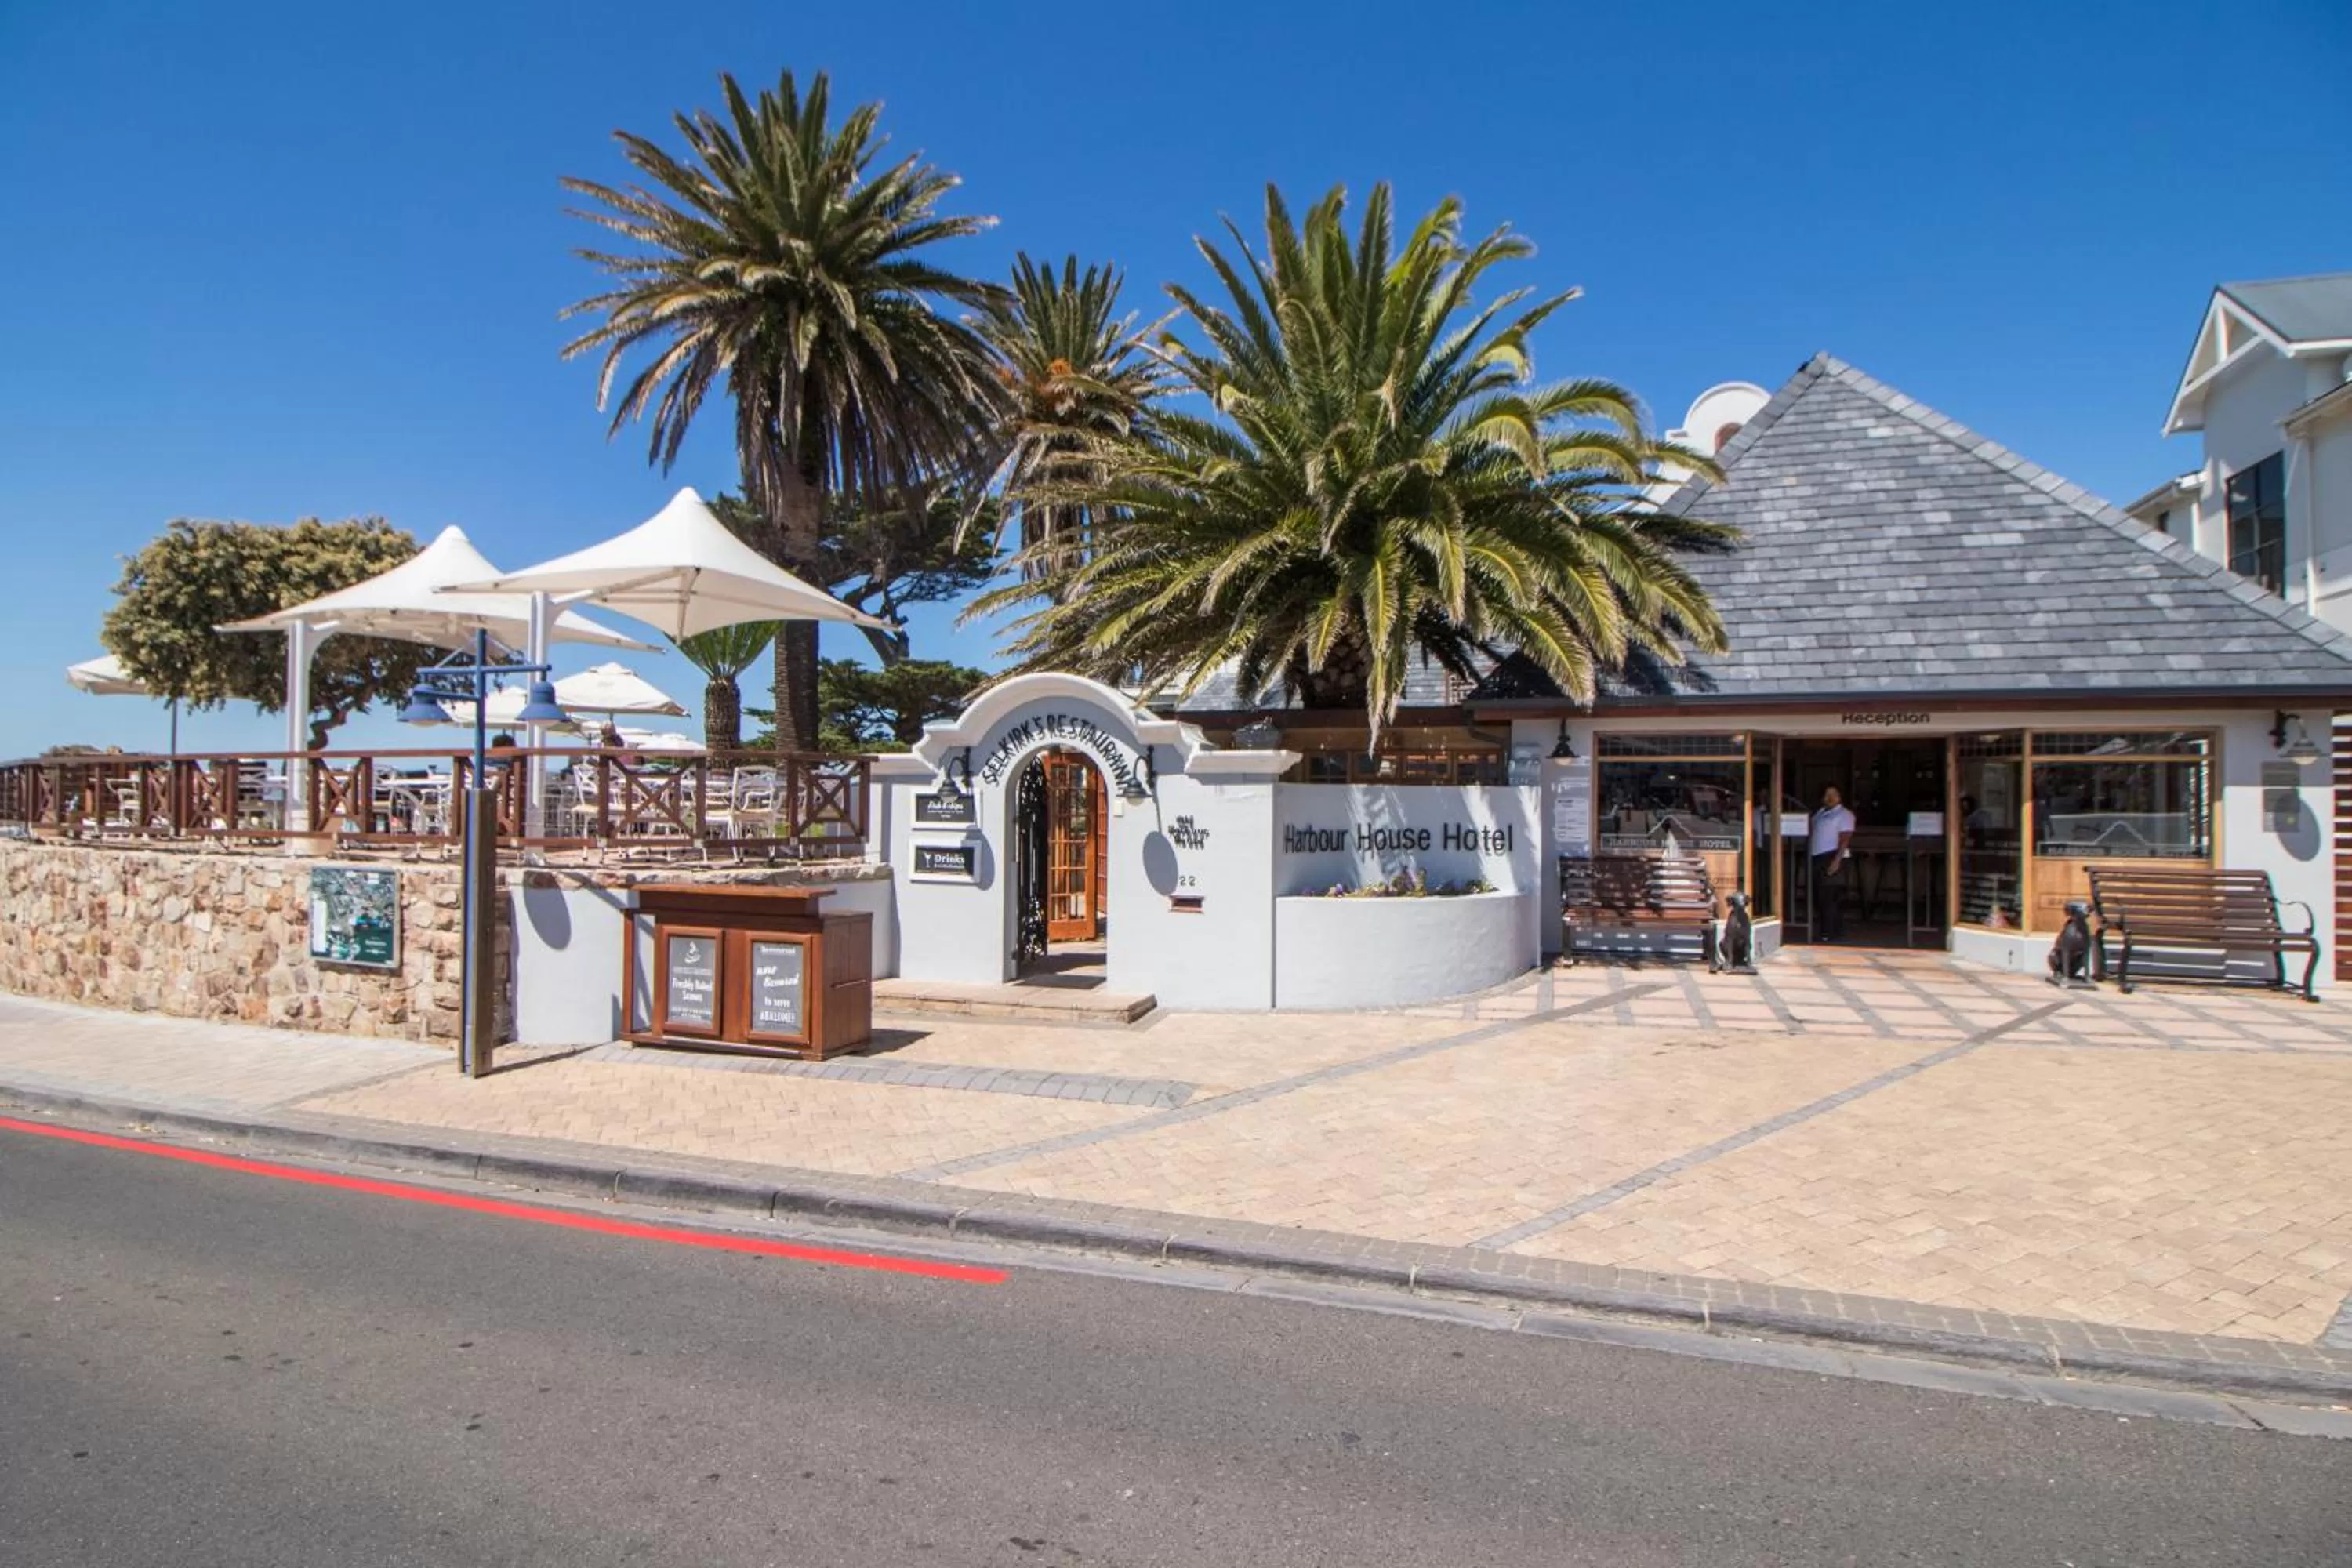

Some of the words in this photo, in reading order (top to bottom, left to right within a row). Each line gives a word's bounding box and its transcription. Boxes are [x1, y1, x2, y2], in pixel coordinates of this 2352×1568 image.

[1841, 711, 1931, 726] Reception
[982, 716, 1045, 786] SELKIRK'S
[1283, 823, 1349, 854] Harbour
[1357, 822, 1432, 852] House
[1443, 822, 1514, 852] Hotel
